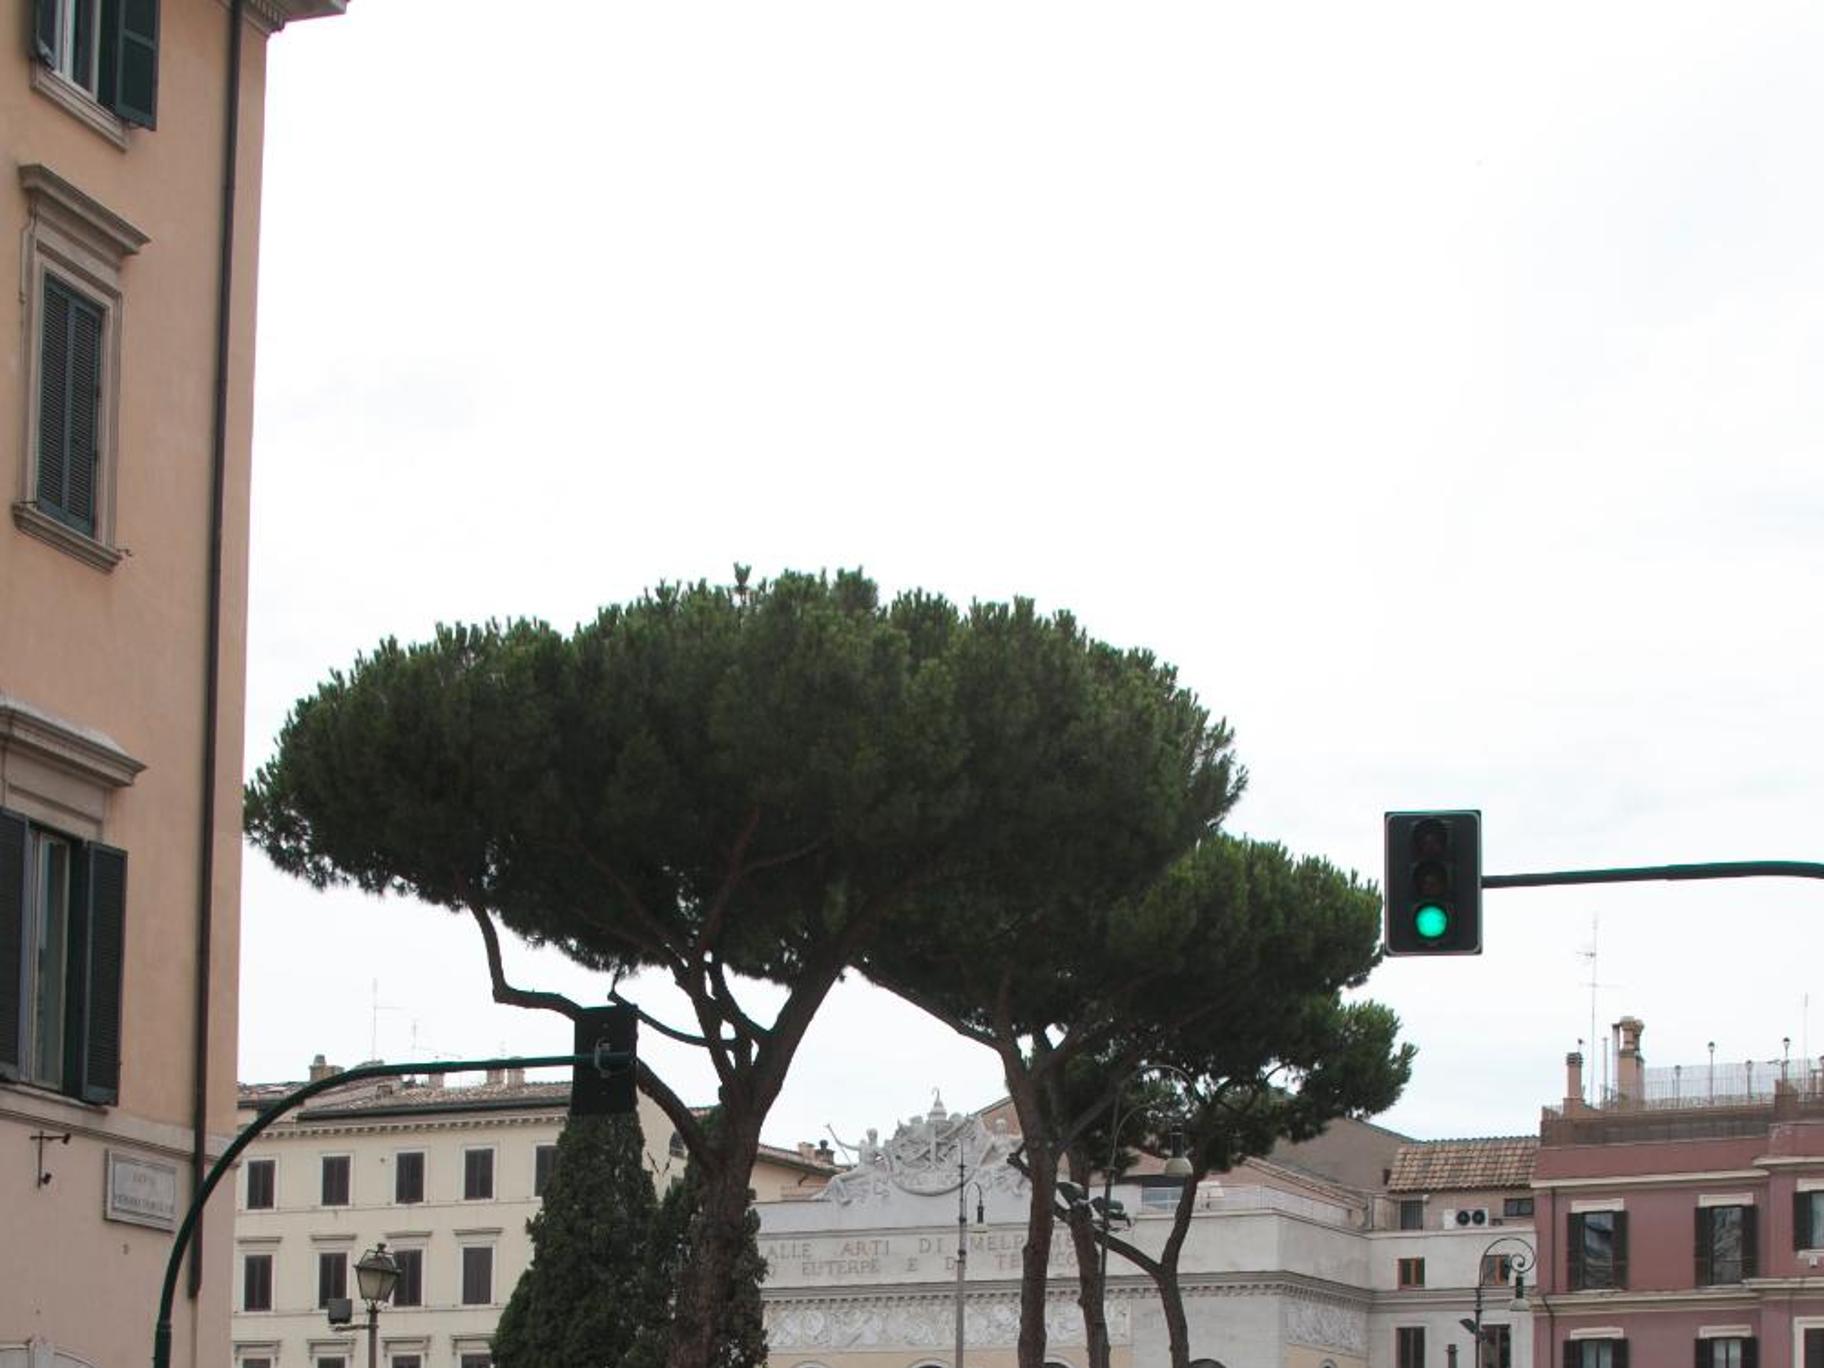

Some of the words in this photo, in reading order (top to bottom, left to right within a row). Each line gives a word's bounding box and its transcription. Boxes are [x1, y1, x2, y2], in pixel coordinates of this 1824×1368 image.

[840, 1239, 890, 1256] ARTI
[919, 1237, 943, 1254] DI
[905, 1257, 918, 1272] E
